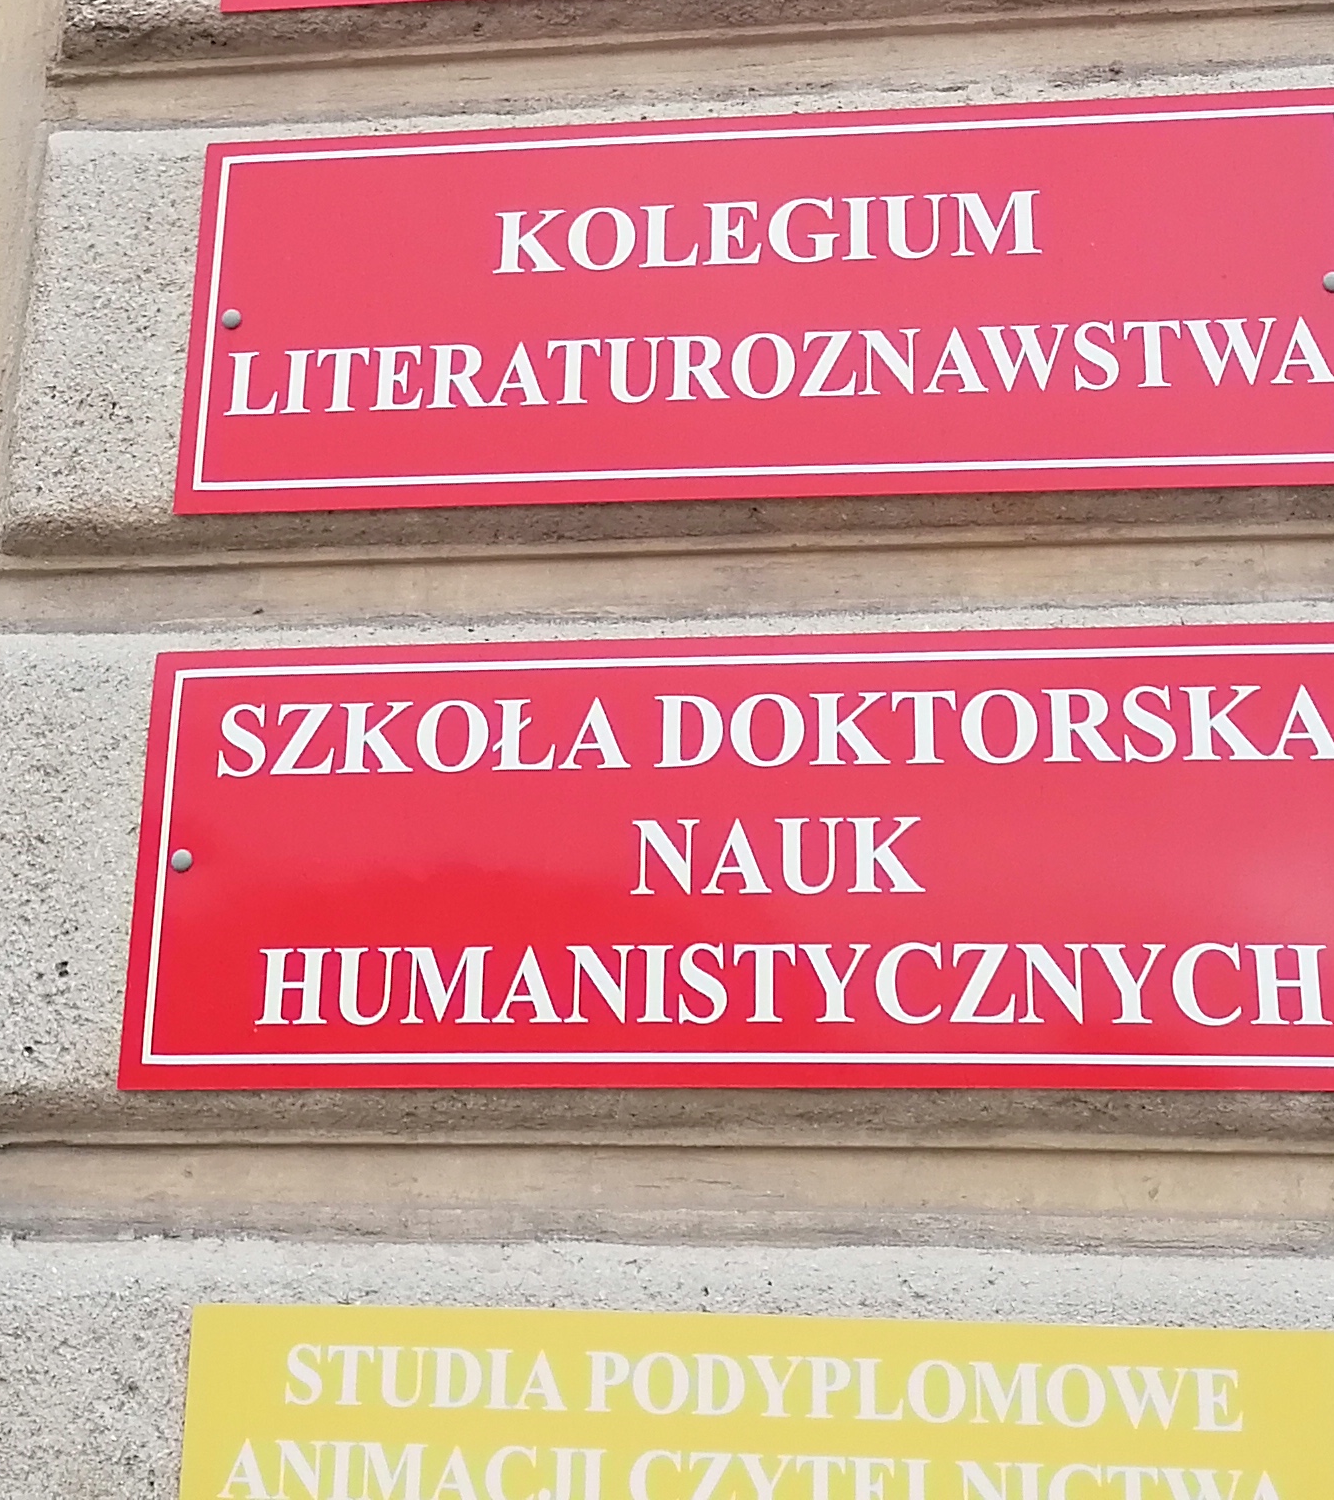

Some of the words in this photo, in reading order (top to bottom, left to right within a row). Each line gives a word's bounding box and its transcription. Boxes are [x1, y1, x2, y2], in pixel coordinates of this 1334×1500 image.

[492, 190, 1043, 275] KOLEGIUM
[217, 697, 631, 780] SZKOŁA
[630, 816, 926, 896] NAUK
[254, 941, 1333, 1027] HUMANISTYCZNYCH
[284, 1342, 567, 1412] STUDIA
[585, 1350, 1244, 1433] PODYPLOMOWE
[217, 1438, 607, 1500] ANIMACJI
